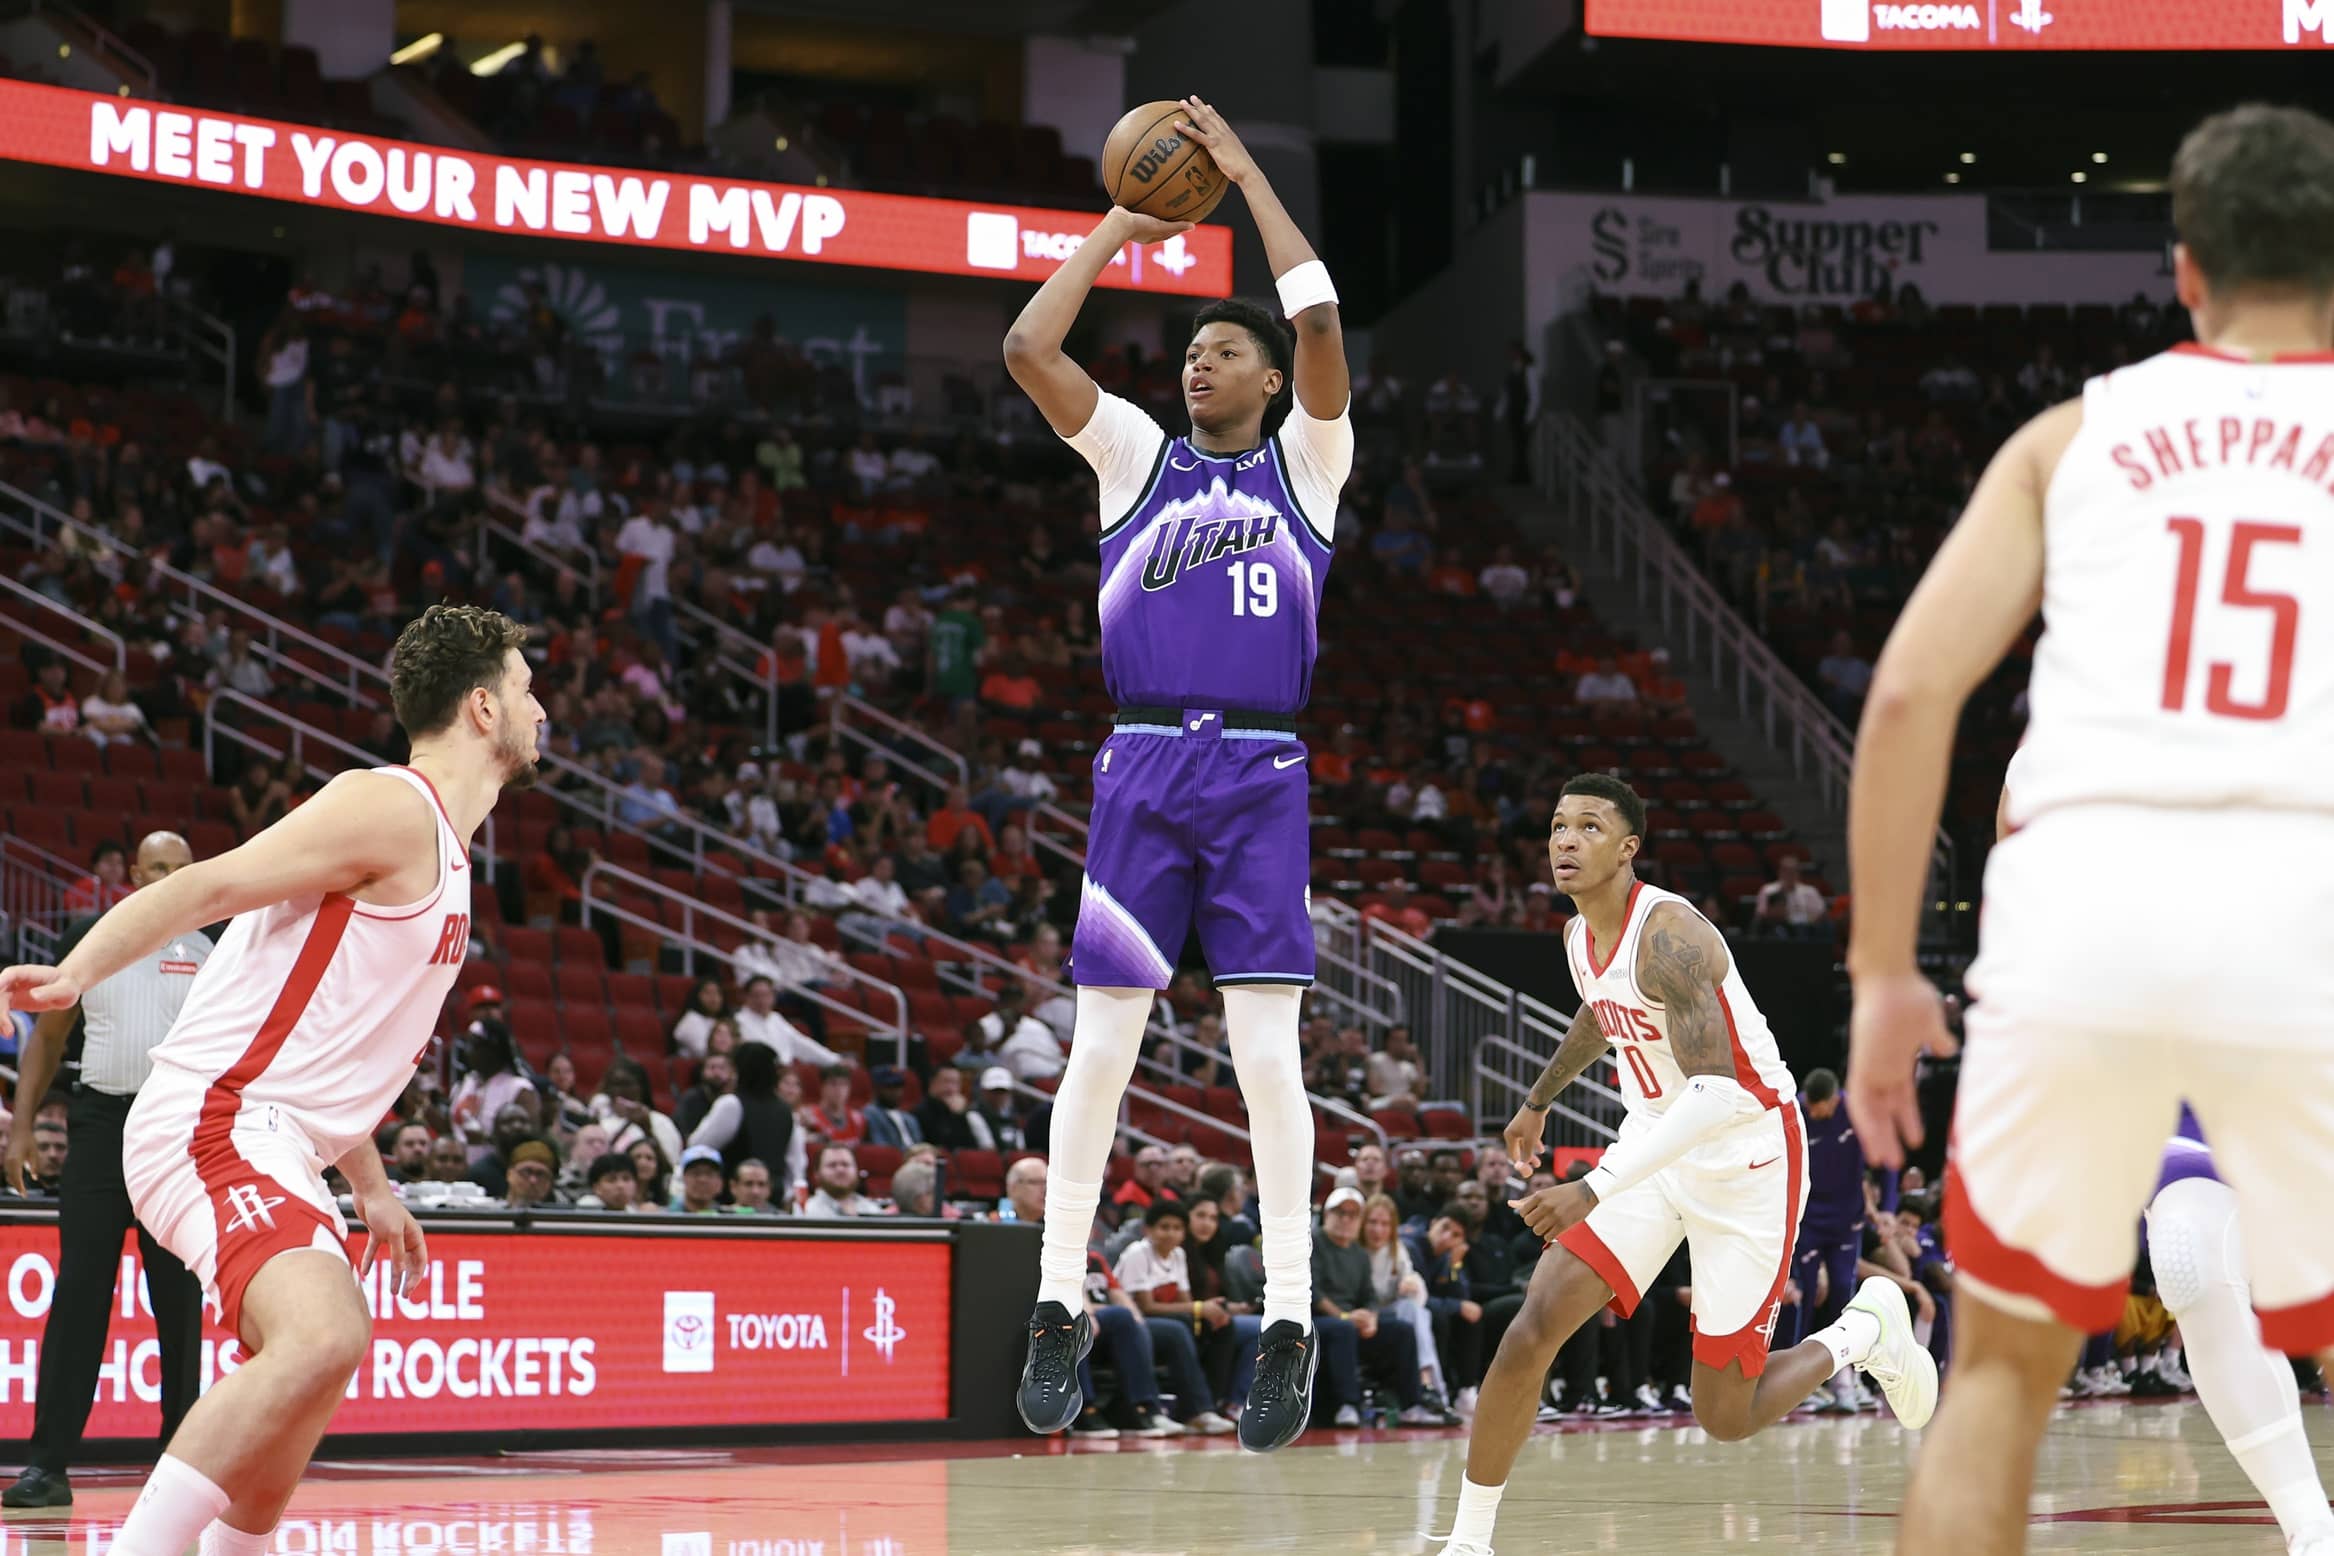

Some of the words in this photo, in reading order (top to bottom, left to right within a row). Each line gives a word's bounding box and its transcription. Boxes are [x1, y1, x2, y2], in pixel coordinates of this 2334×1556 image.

[1874, 3, 1980, 30] TACOMA
[90, 102, 275, 189] MEET
[291, 133, 477, 221] YOUR
[494, 165, 671, 240] NEW
[689, 184, 846, 256] MVP
[1131, 120, 1199, 184] Wils
[1021, 229, 1127, 268] TACO
[1731, 204, 1939, 266] Supper
[1766, 250, 1892, 298] Club
[2110, 415, 2334, 496] SHEPPAR
[1141, 511, 1283, 593] UTAH
[1227, 560, 1278, 618] 19
[2159, 514, 2303, 722] 15
[1623, 1045, 1663, 1099] 0
[726, 1313, 829, 1351] TOYOTA
[372, 1337, 597, 1399] ROCKETS
